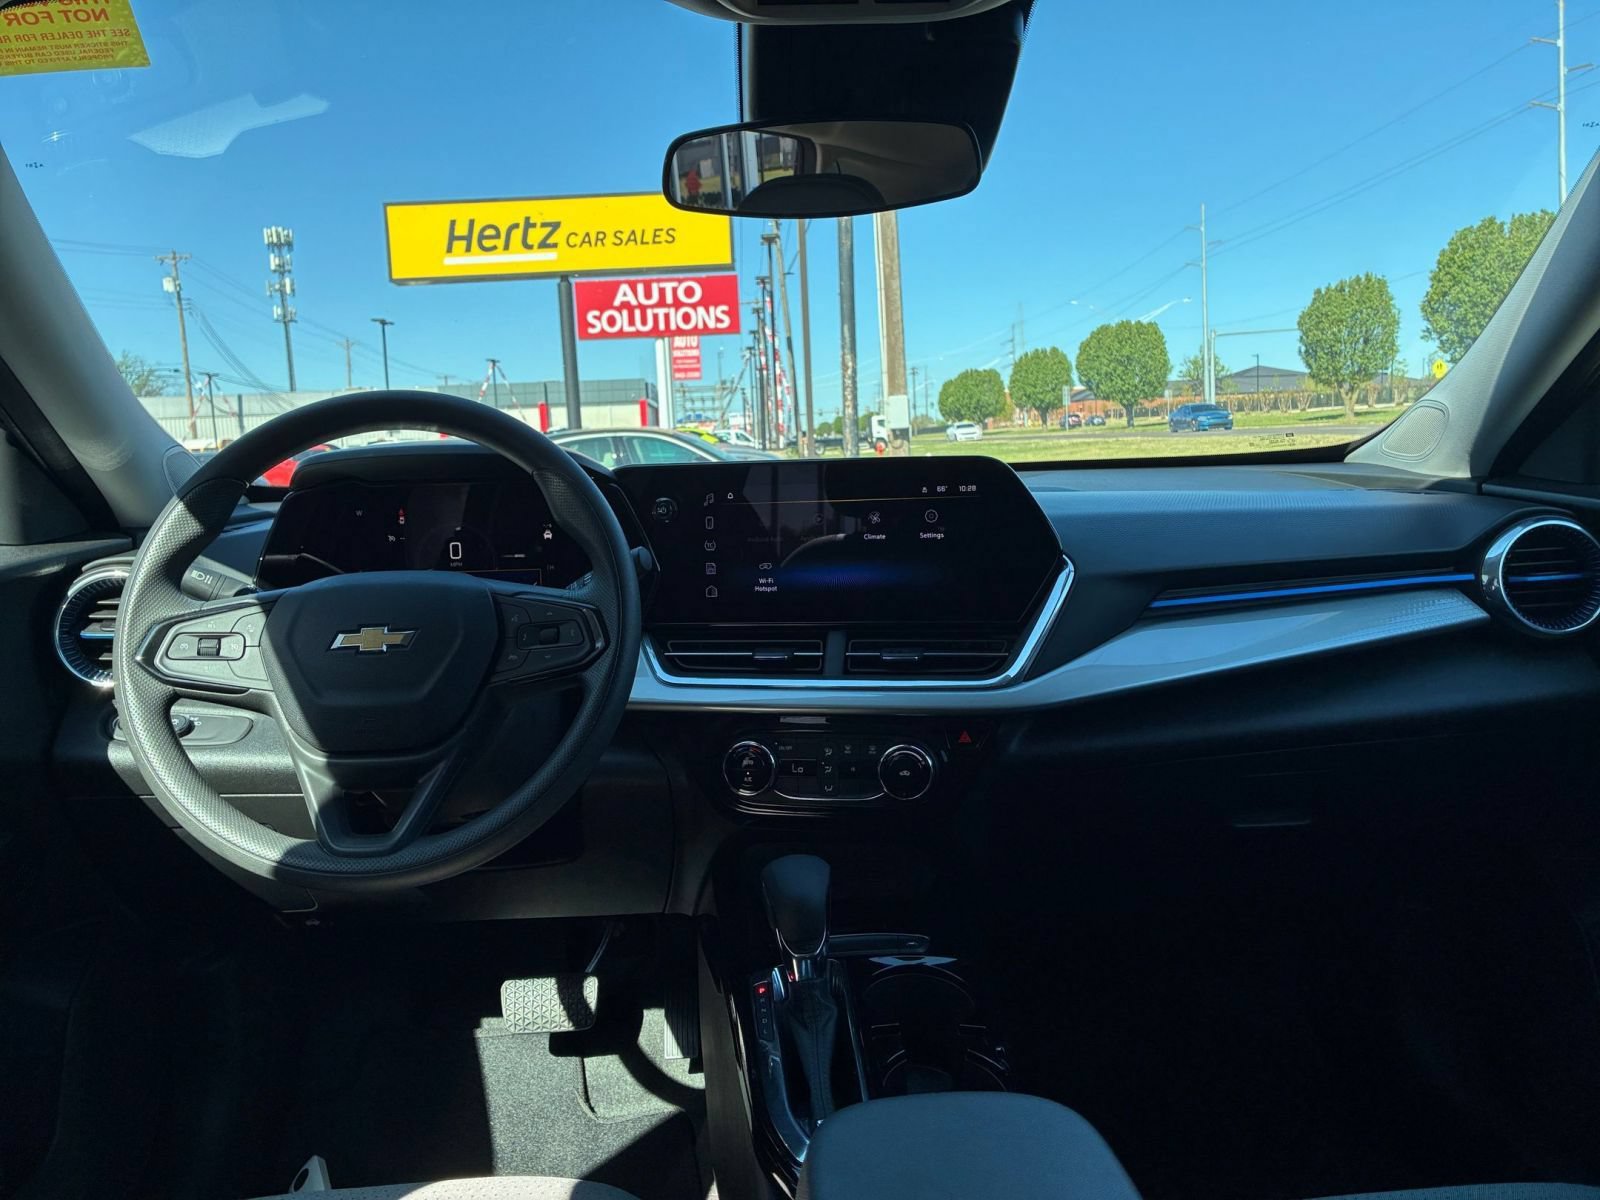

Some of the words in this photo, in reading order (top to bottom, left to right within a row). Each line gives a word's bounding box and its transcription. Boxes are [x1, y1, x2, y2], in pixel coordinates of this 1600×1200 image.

[445, 216, 562, 254] Hertz
[566, 231, 607, 249] CAR
[612, 227, 676, 247] SALES
[613, 280, 703, 306] AUTO
[586, 305, 731, 335] SOLUTIONS
[919, 531, 945, 540] Settings
[754, 585, 778, 593] Hotspot
